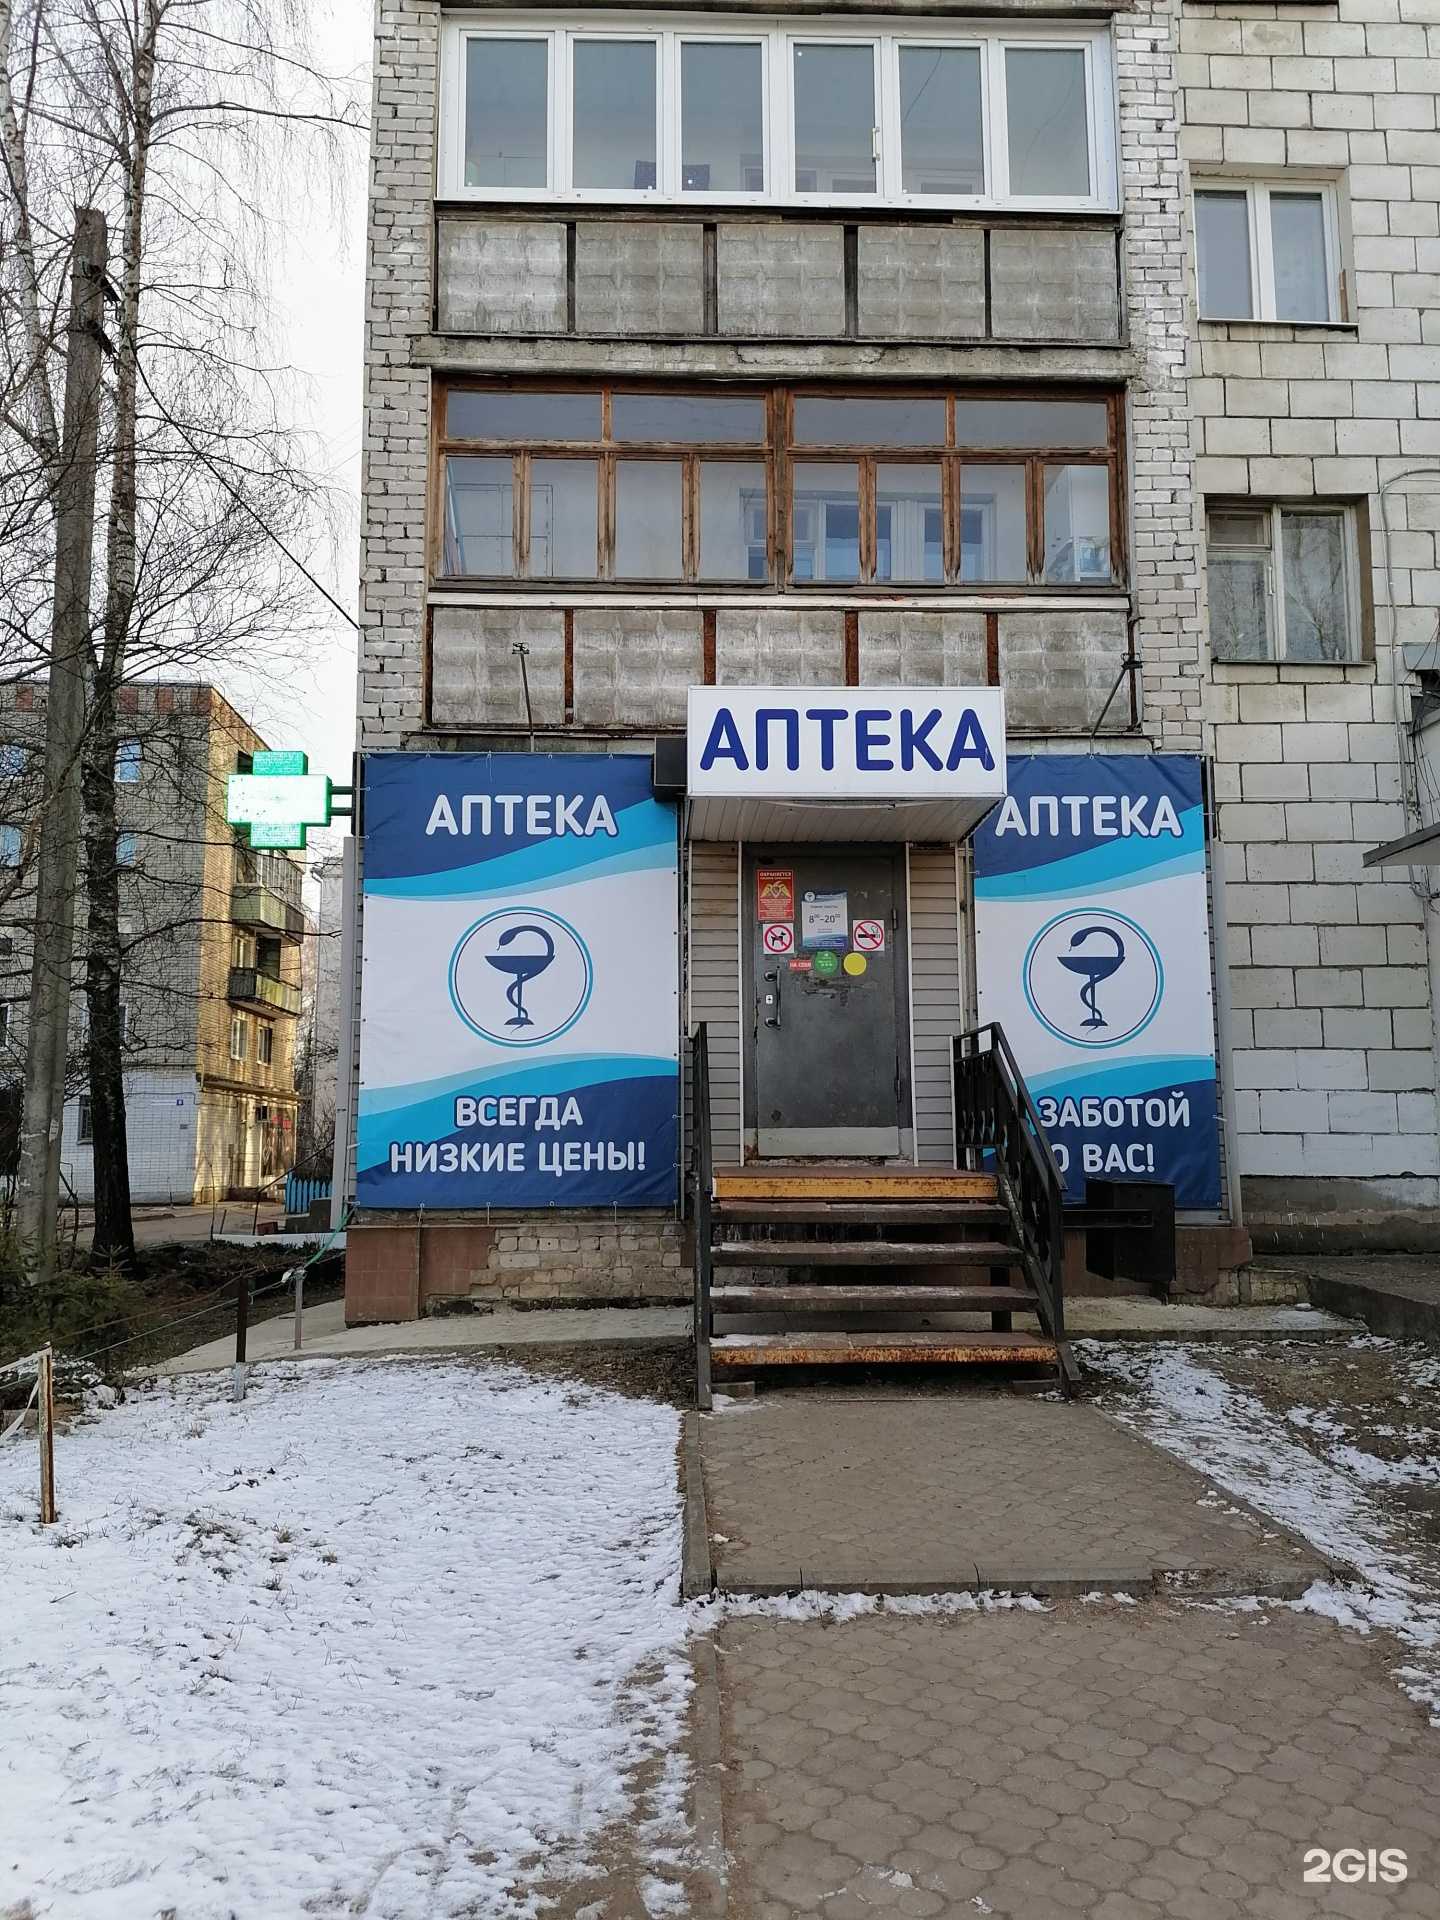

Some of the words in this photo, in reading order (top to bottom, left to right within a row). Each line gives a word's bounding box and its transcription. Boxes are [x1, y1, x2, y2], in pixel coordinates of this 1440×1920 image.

[699, 707, 996, 772] АПТЕКА
[424, 793, 618, 837] АПТЕКА
[994, 794, 1183, 838] АПТЕКА
[455, 1095, 584, 1132] ВСЕГДА
[1038, 1090, 1191, 1128] ЗАБОТОЙ
[390, 1141, 526, 1173] НИЗКИЕ
[537, 1140, 647, 1177] ЦЕНЫ!
[1082, 1143, 1155, 1173] ВАС!
